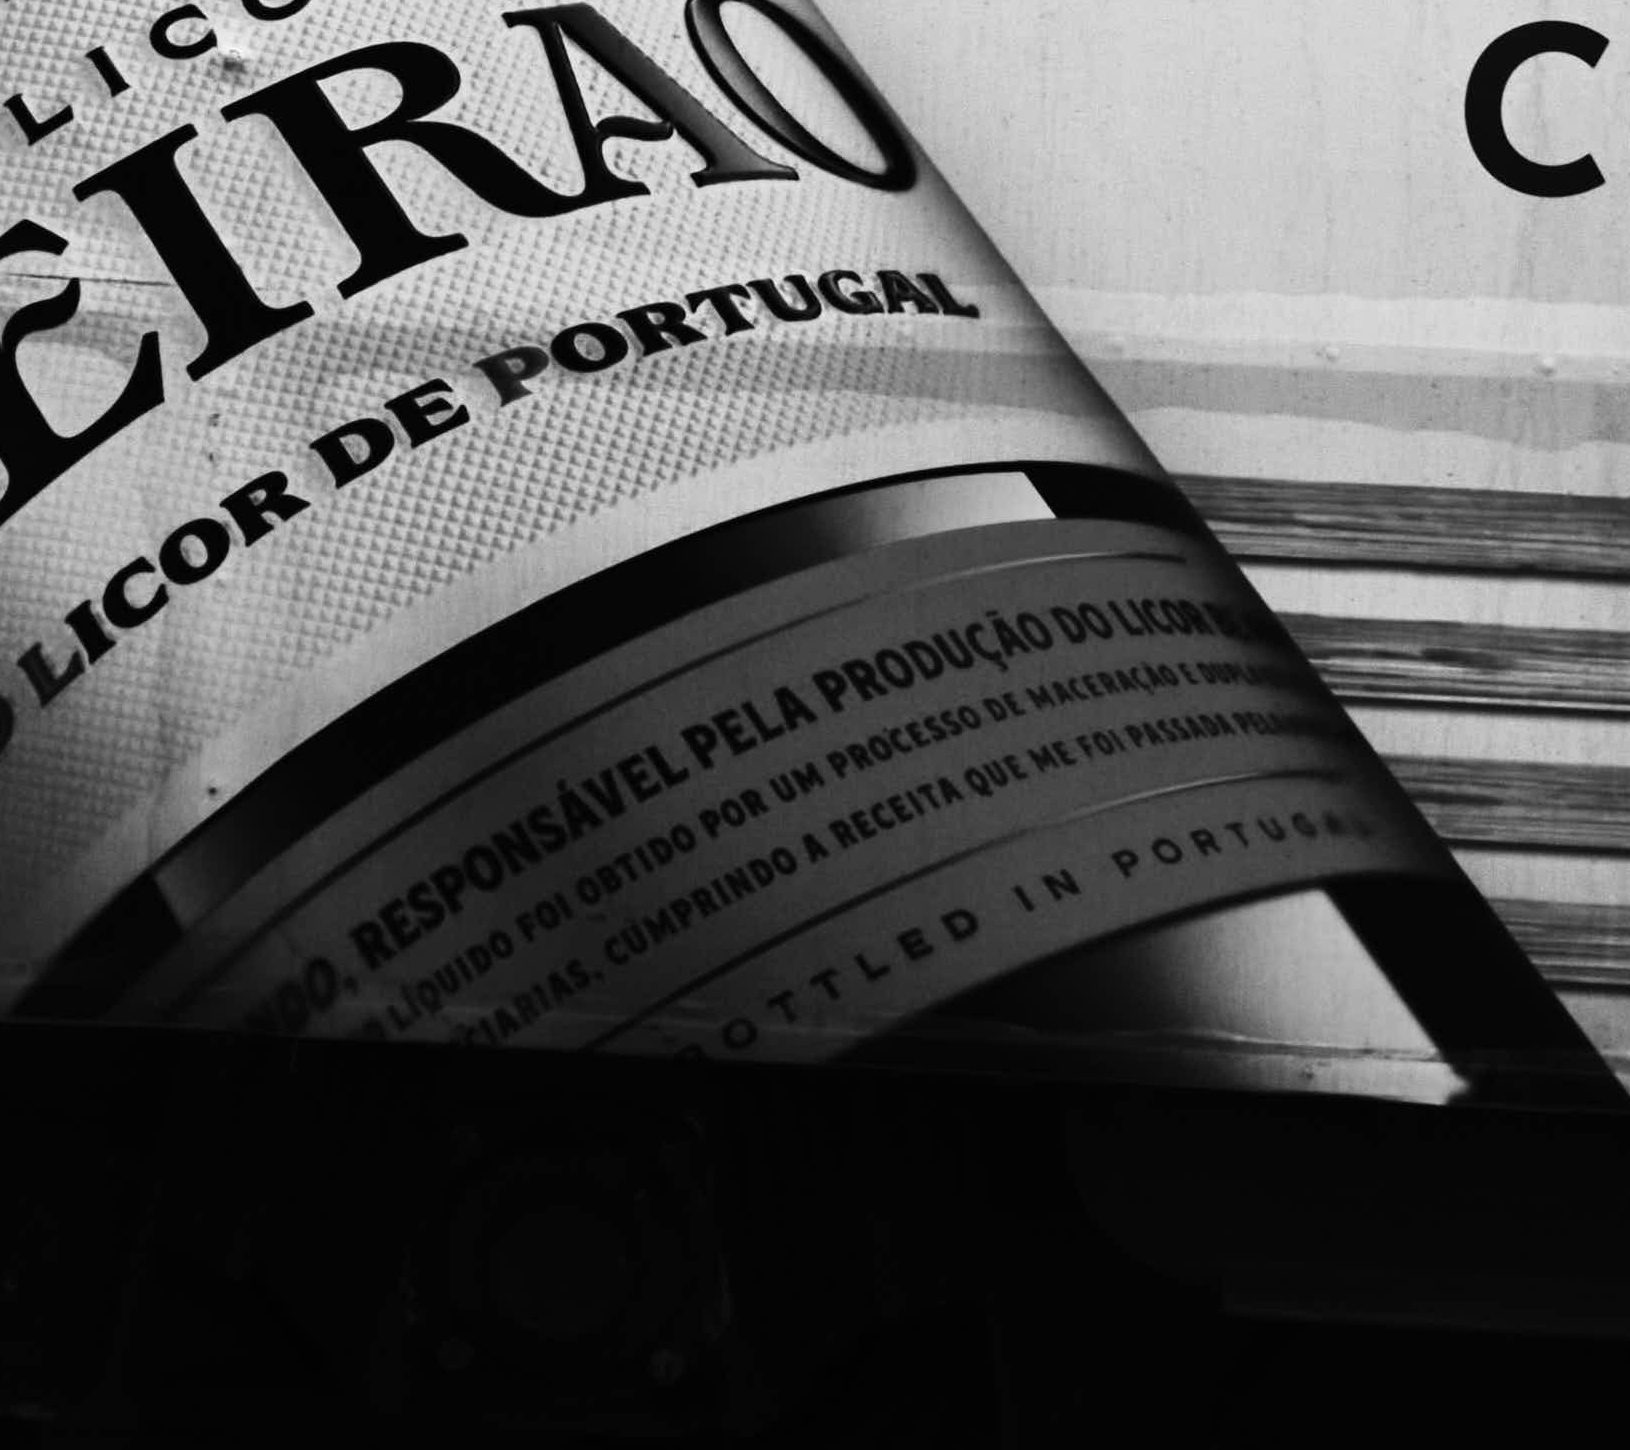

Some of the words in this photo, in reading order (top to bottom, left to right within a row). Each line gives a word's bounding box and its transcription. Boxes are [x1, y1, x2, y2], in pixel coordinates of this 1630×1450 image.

[20, 468, 312, 703] LICOR
[310, 375, 473, 491] DE
[476, 268, 982, 406] PORTUGAL
[349, 752, 691, 971] RESPONSÁVEL
[680, 687, 817, 774] PELA
[811, 607, 1054, 713] PRODUÇÃO
[1048, 600, 1117, 648] DO
[514, 892, 574, 943] FOI
[576, 824, 697, 906] OBTIDO
[699, 787, 770, 841] POR
[769, 761, 825, 804] UM
[826, 705, 982, 779] PROCESSO
[982, 692, 1026, 723] DE
[1025, 661, 1180, 715] MACERAÇÃO
[1178, 662, 1198, 685] E
[604, 847, 798, 965] CUMPRINDO
[801, 832, 830, 864] A
[828, 777, 964, 849] RECEITA
[963, 755, 1028, 798] QUE
[1027, 741, 1079, 773] ME
[1076, 728, 1127, 759] FOI
[1124, 711, 1238, 749] PASSADA
[1011, 867, 1080, 915] IN
